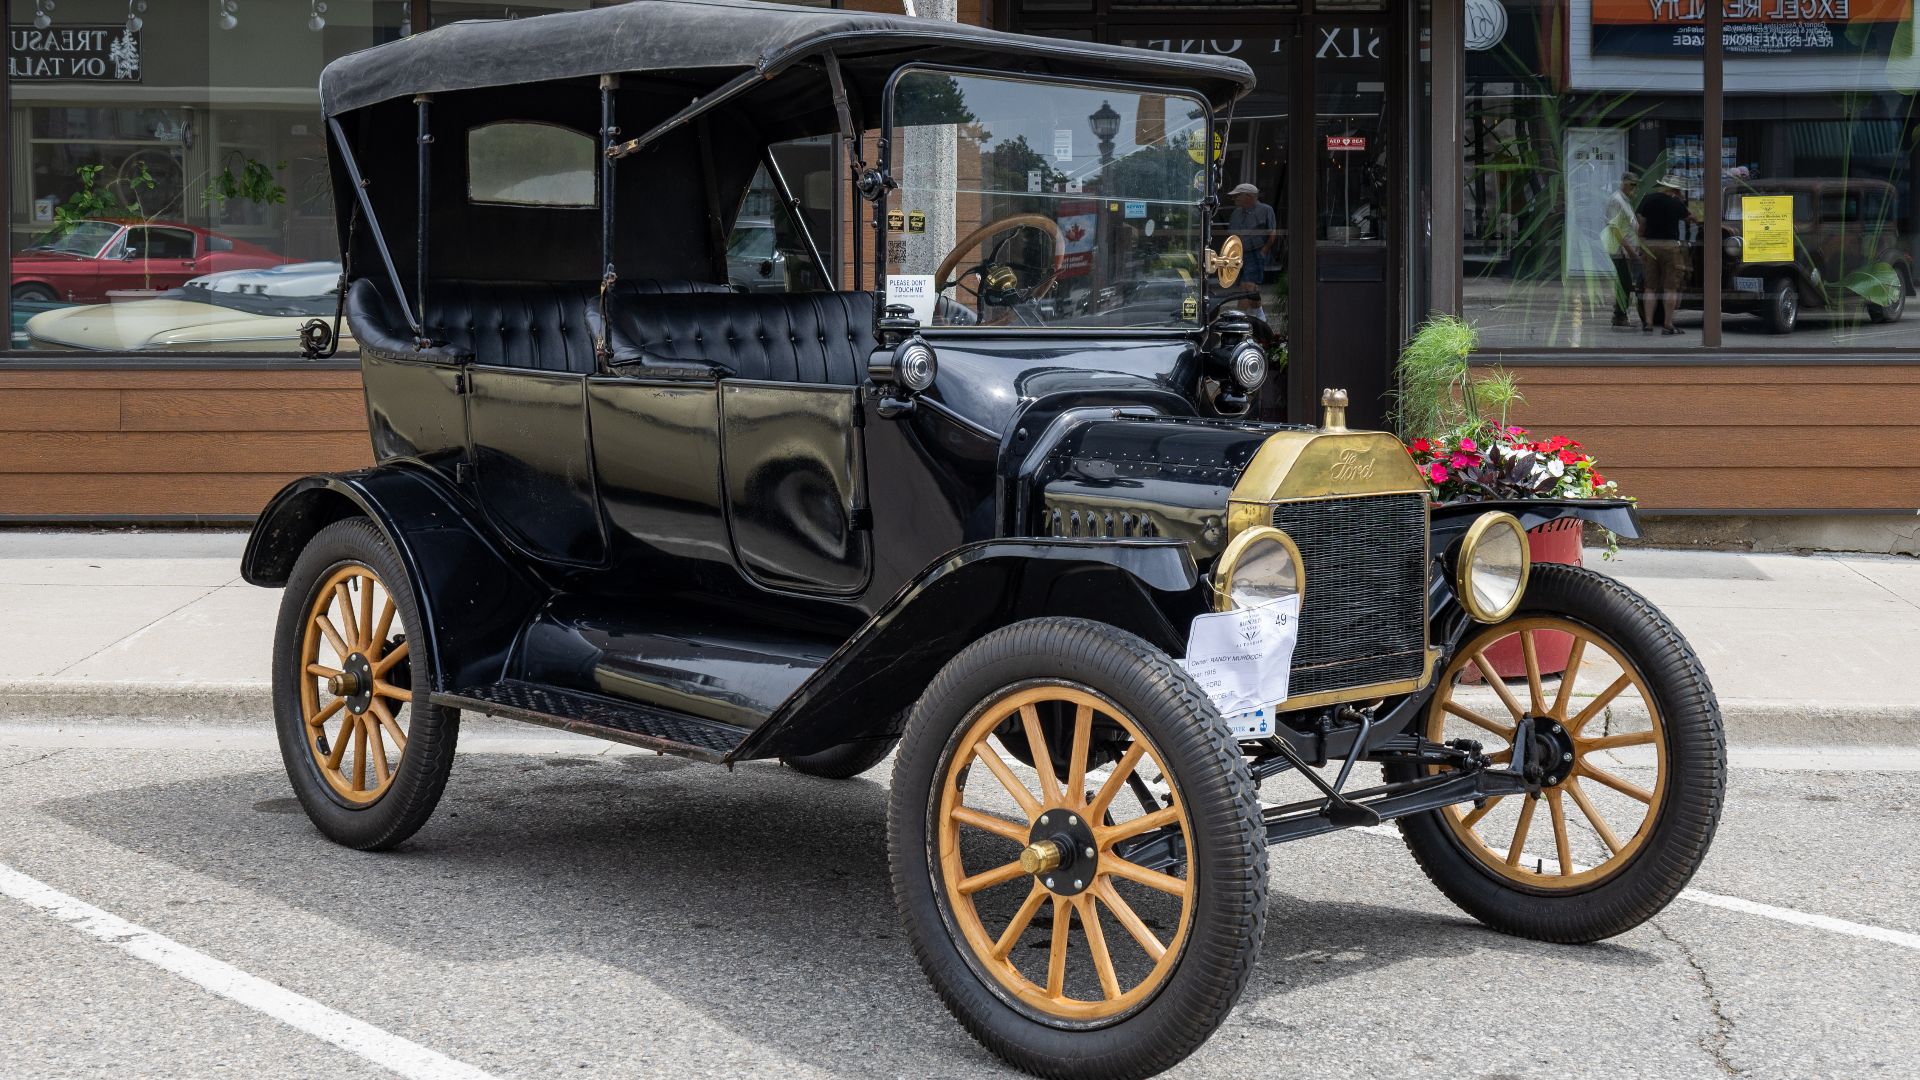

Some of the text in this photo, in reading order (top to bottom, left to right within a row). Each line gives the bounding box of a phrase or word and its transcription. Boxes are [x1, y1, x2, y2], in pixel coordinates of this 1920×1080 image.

[1330, 448, 1376, 481] Ford
[1275, 613, 1287, 626] 49
[1210, 654, 1232, 662] RANDY
